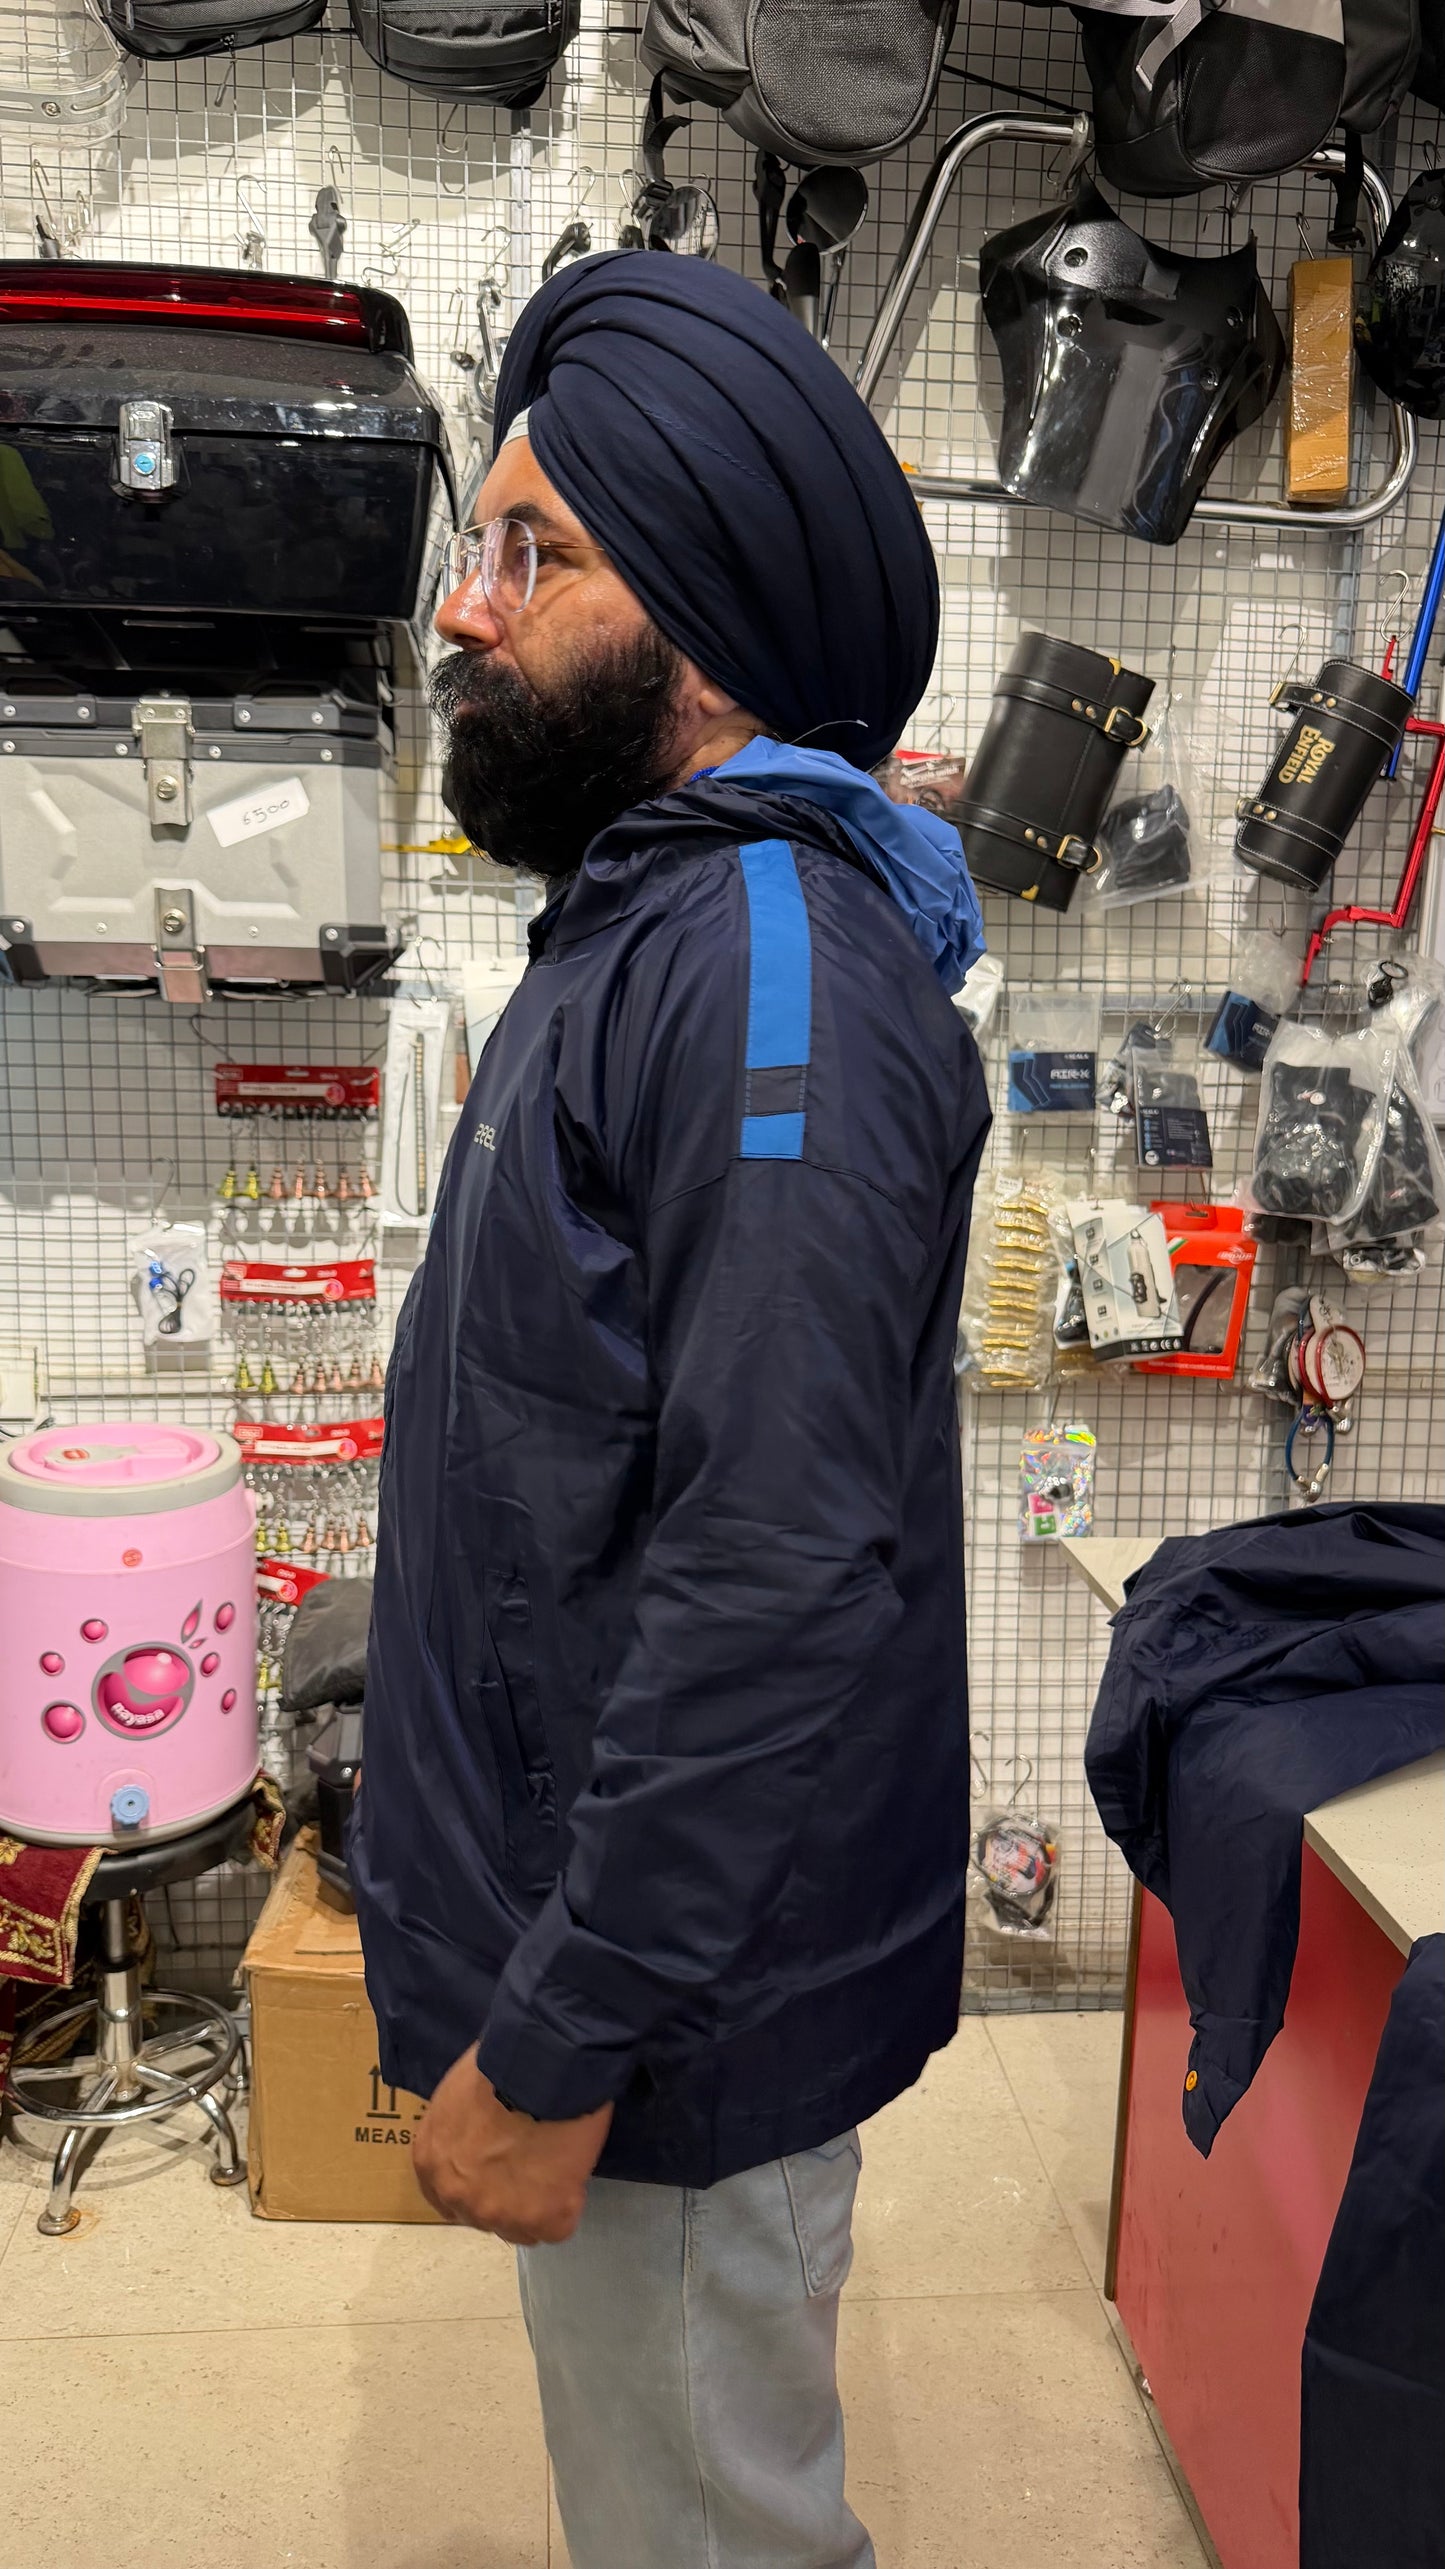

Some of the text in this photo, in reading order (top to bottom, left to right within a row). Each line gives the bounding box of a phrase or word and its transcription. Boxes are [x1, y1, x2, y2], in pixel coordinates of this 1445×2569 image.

[1278, 724, 1322, 784] ENFIELD
[1296, 737, 1336, 784] ROYAL
[243, 800, 289, 825] 6500
